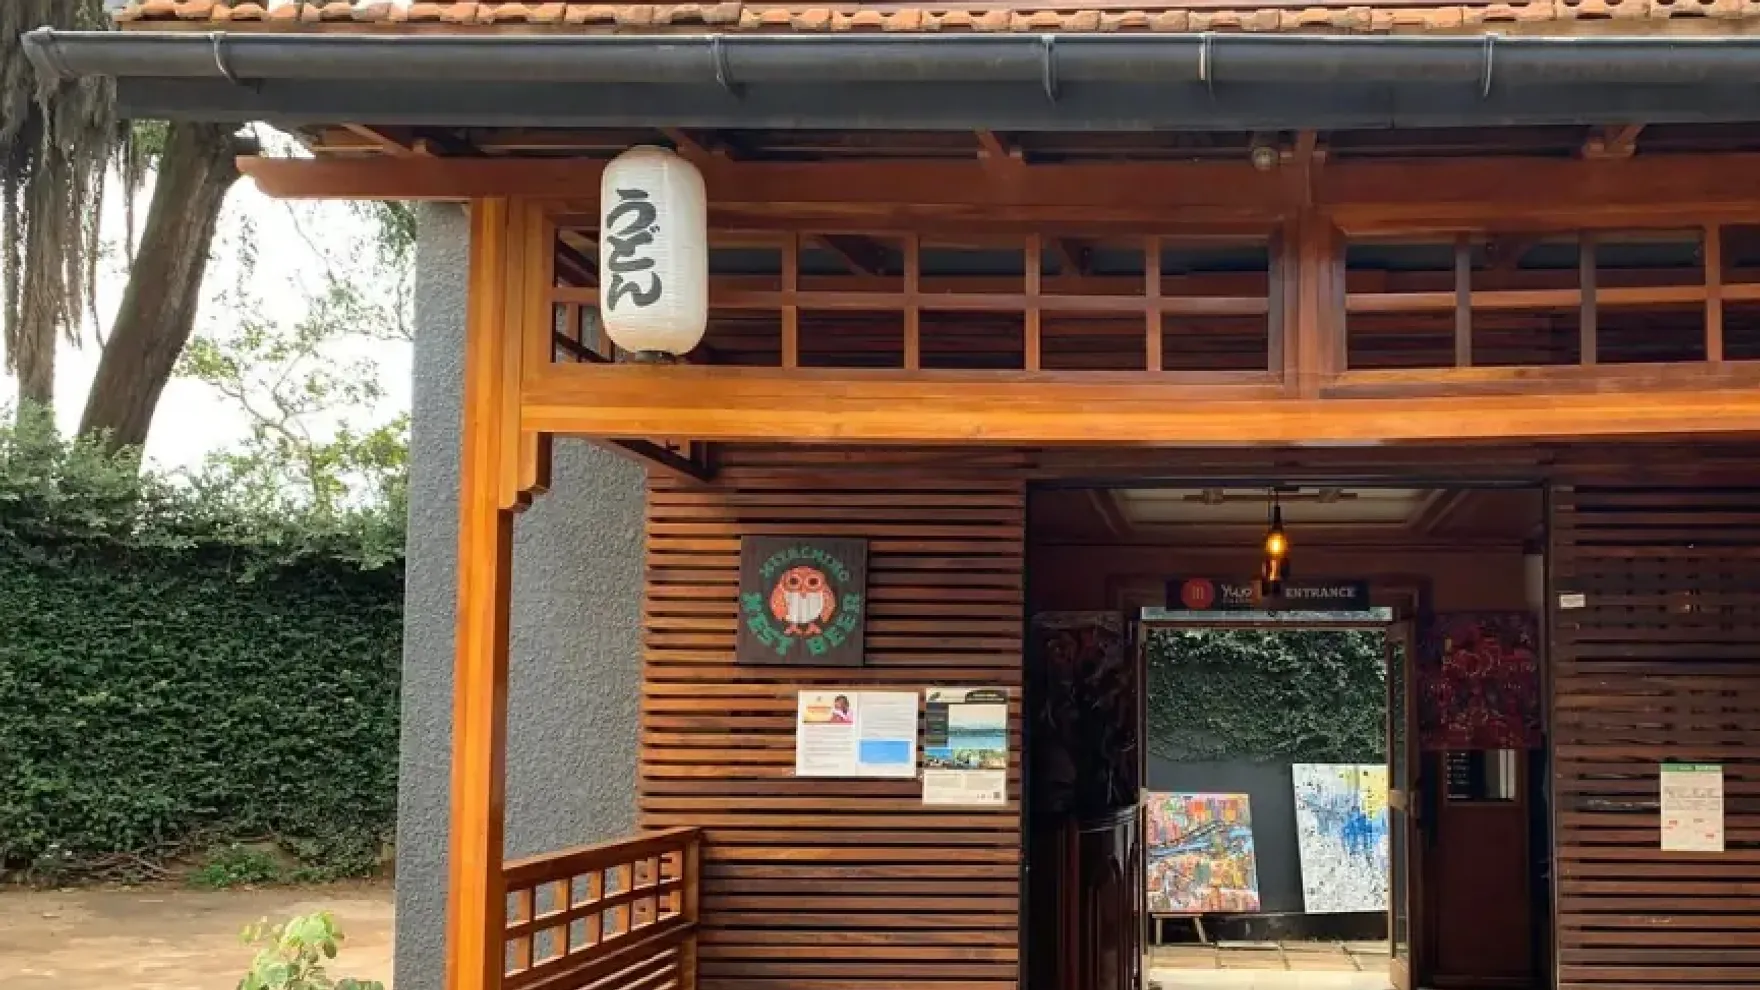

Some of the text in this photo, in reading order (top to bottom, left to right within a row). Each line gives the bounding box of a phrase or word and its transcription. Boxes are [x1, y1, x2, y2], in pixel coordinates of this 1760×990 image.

[606, 188, 662, 312] うどん
[741, 592, 861, 656] NEST BEER
[1286, 587, 1357, 599] ENTRANCE
